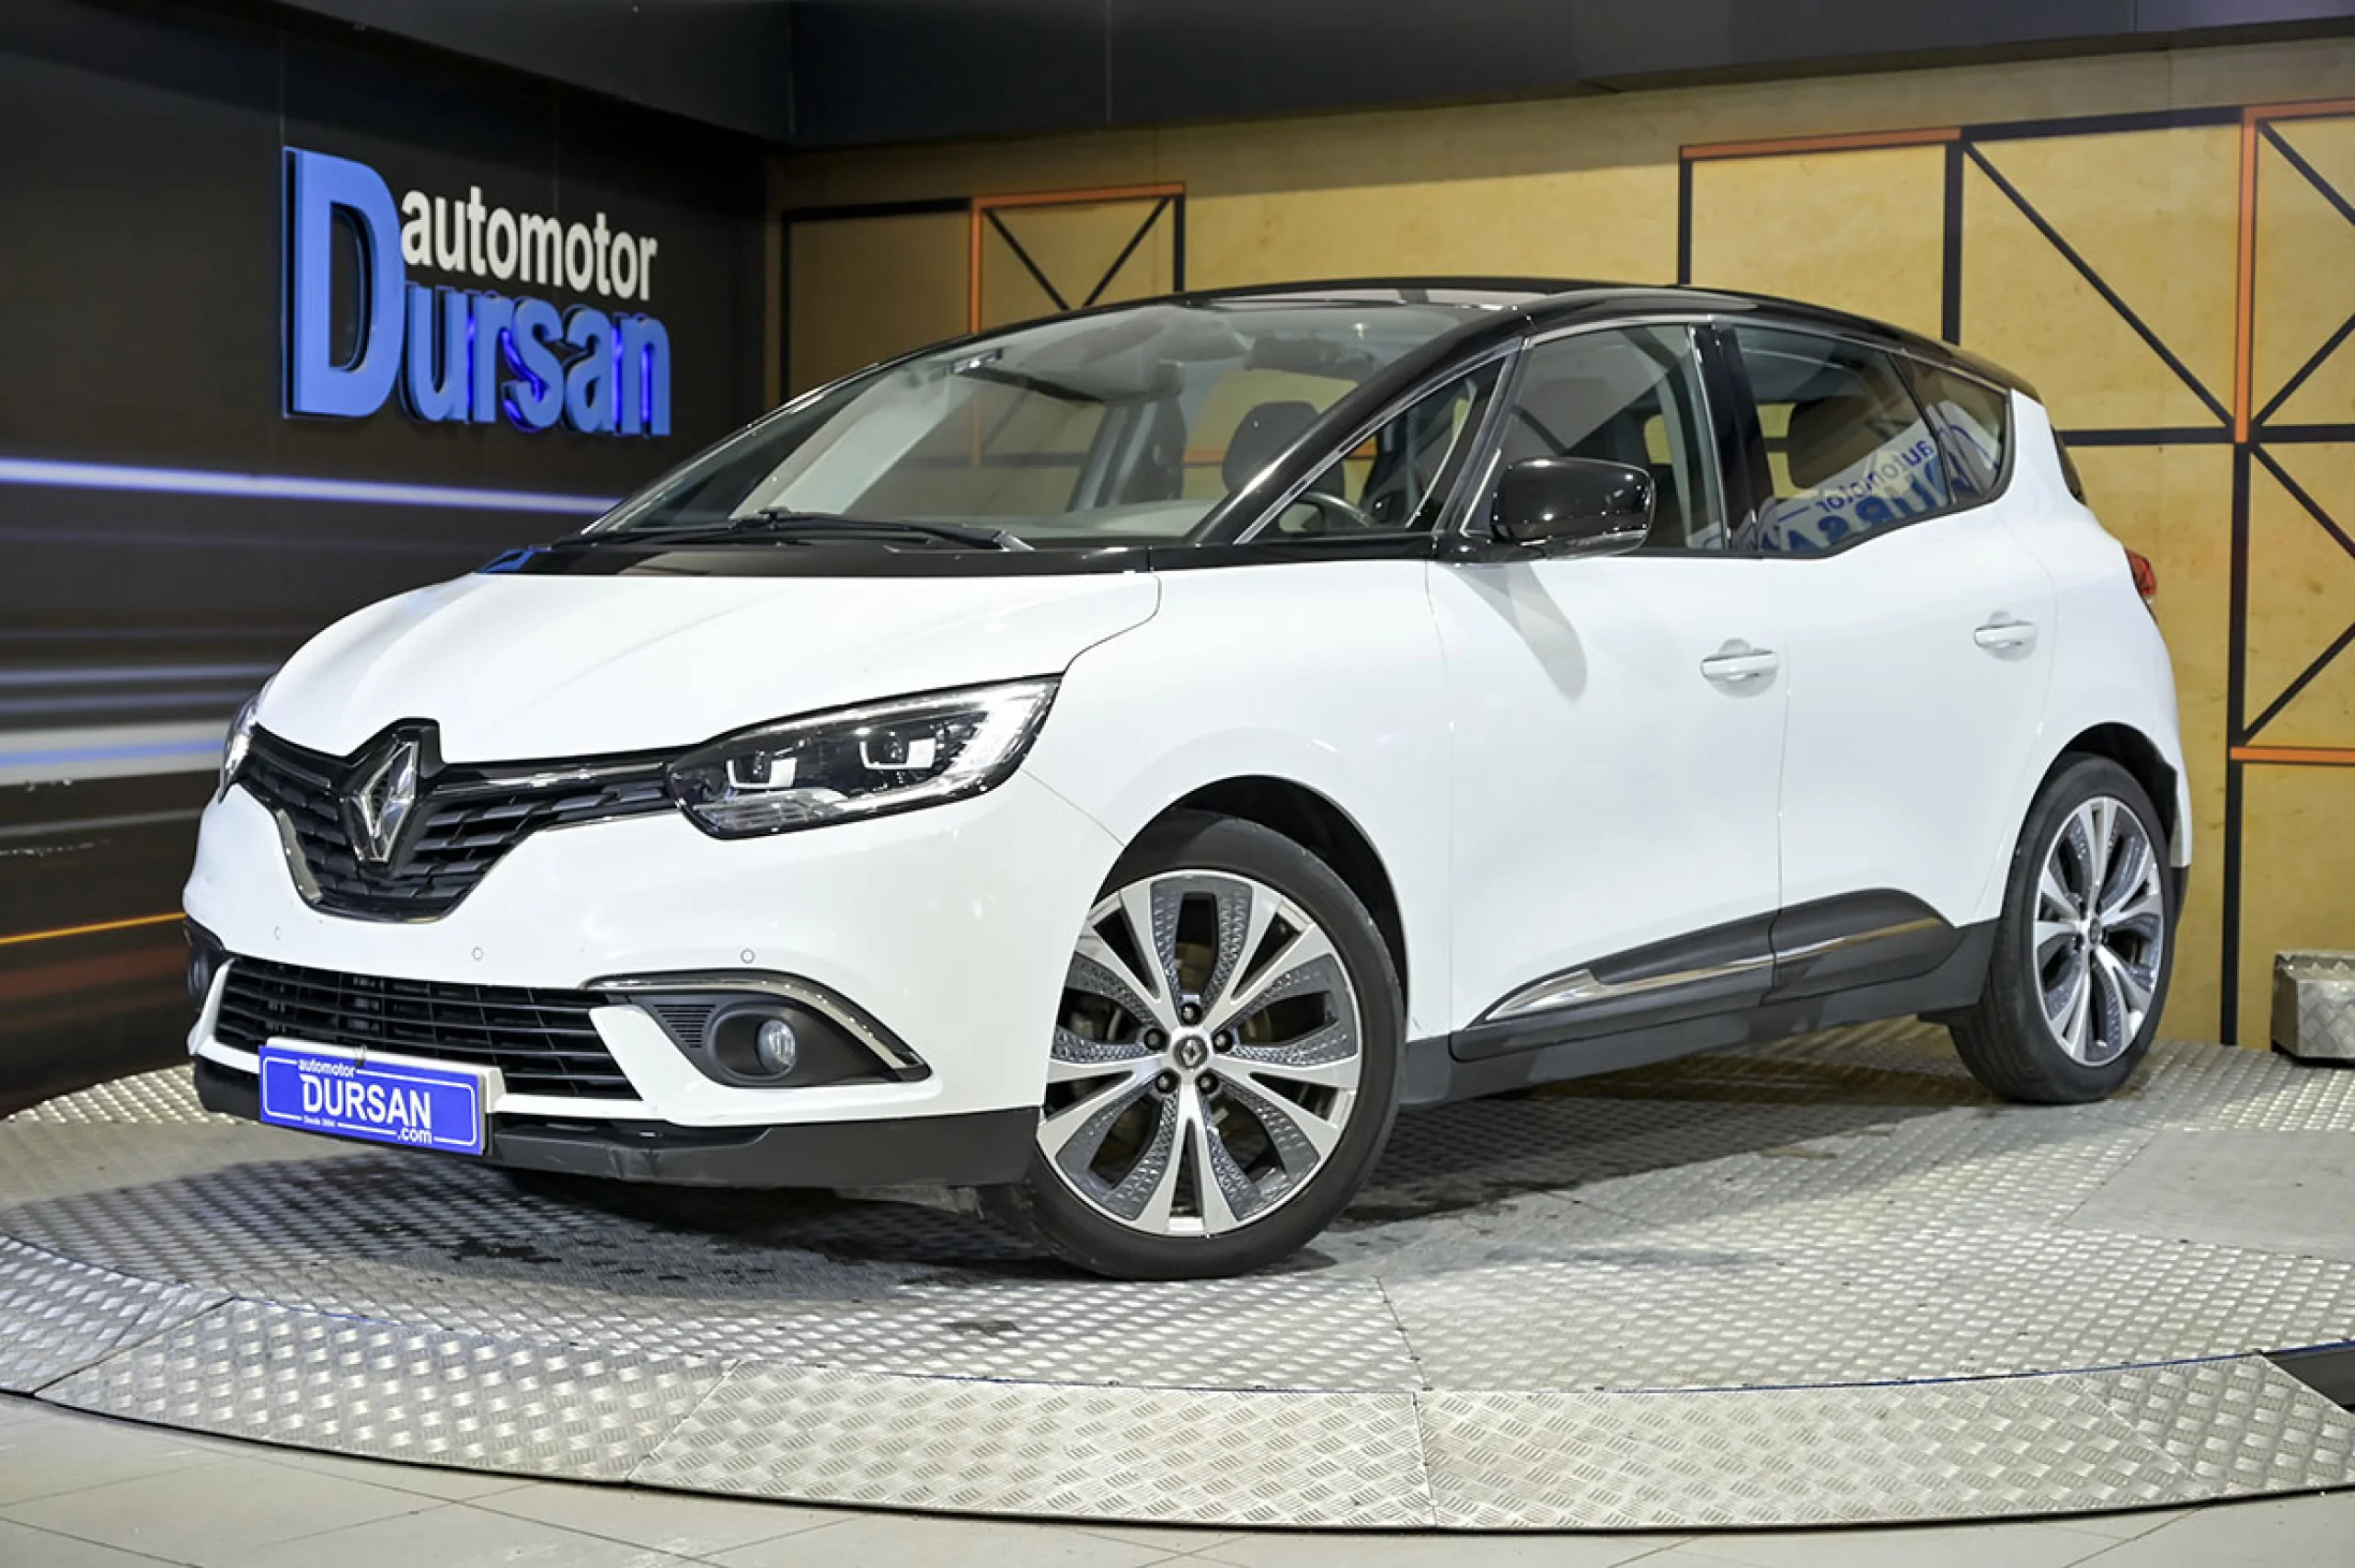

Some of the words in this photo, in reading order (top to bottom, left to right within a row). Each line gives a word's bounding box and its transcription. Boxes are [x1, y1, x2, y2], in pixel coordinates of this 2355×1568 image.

[401, 186, 657, 301] automotor
[283, 146, 672, 437] Dursan
[298, 1059, 355, 1078] automotor
[300, 1073, 431, 1129] DURSAN
[397, 1127, 432, 1144] .com
